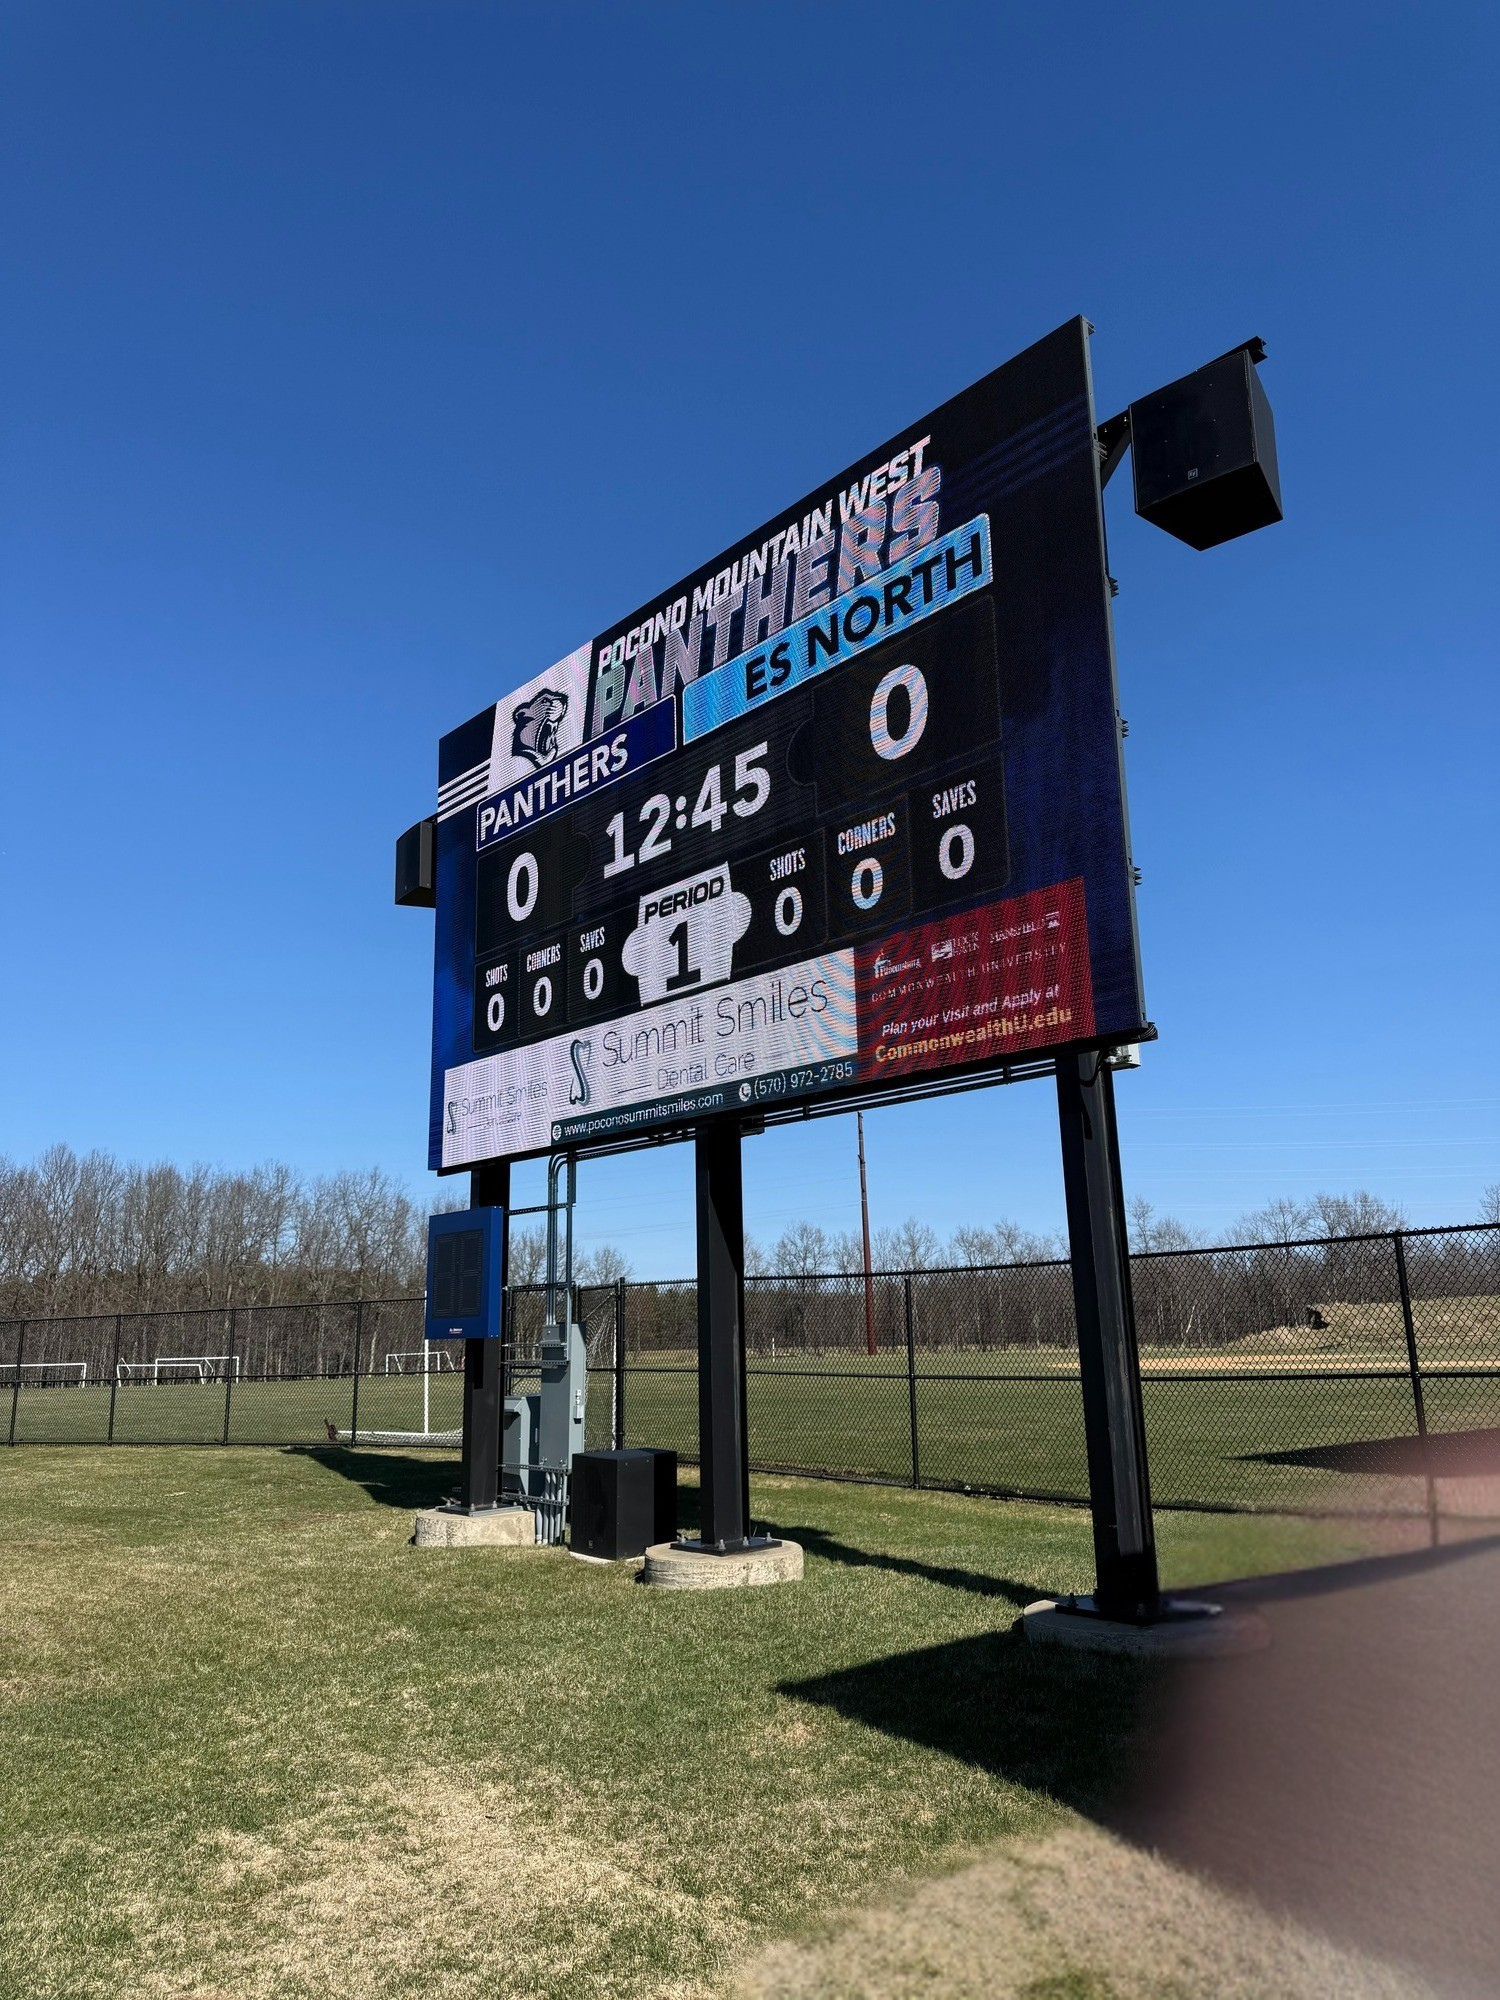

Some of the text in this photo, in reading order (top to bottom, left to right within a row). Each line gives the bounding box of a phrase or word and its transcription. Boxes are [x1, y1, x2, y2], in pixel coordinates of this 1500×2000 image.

[598, 434, 931, 678] POCONO MOUNTAIN WEST
[591, 466, 941, 738] PANTHERS
[746, 532, 982, 700] ES NORTH
[870, 664, 929, 760] 0
[480, 733, 628, 842] PANTHERS
[603, 741, 771, 879] 12:45
[931, 779, 977, 819] SAVES
[837, 812, 896, 855] CORNERS
[939, 824, 975, 880] 0
[507, 852, 539, 921] 0
[769, 848, 806, 881] SHOTS
[852, 857, 883, 910] 0
[644, 876, 724, 924] PERIOD
[774, 886, 803, 936] 0
[526, 943, 561, 973] CORNERS
[579, 926, 605, 953] SAVES
[666, 921, 701, 992] 1
[485, 963, 508, 987] SHOTS
[533, 976, 552, 1017] 0
[583, 958, 604, 1000] 0
[487, 993, 505, 1031] 0
[602, 979, 828, 1067] Summit Smiles
[875, 1007, 1071, 1063] CommonwealthU.edu
[881, 983, 1060, 1037] Plan your Visit and Apply at
[657, 1053, 755, 1090] Dental Care
[754, 1062, 853, 1099] (570) 972-2785
[564, 1092, 724, 1134] www.poconosummitsmiles.com
